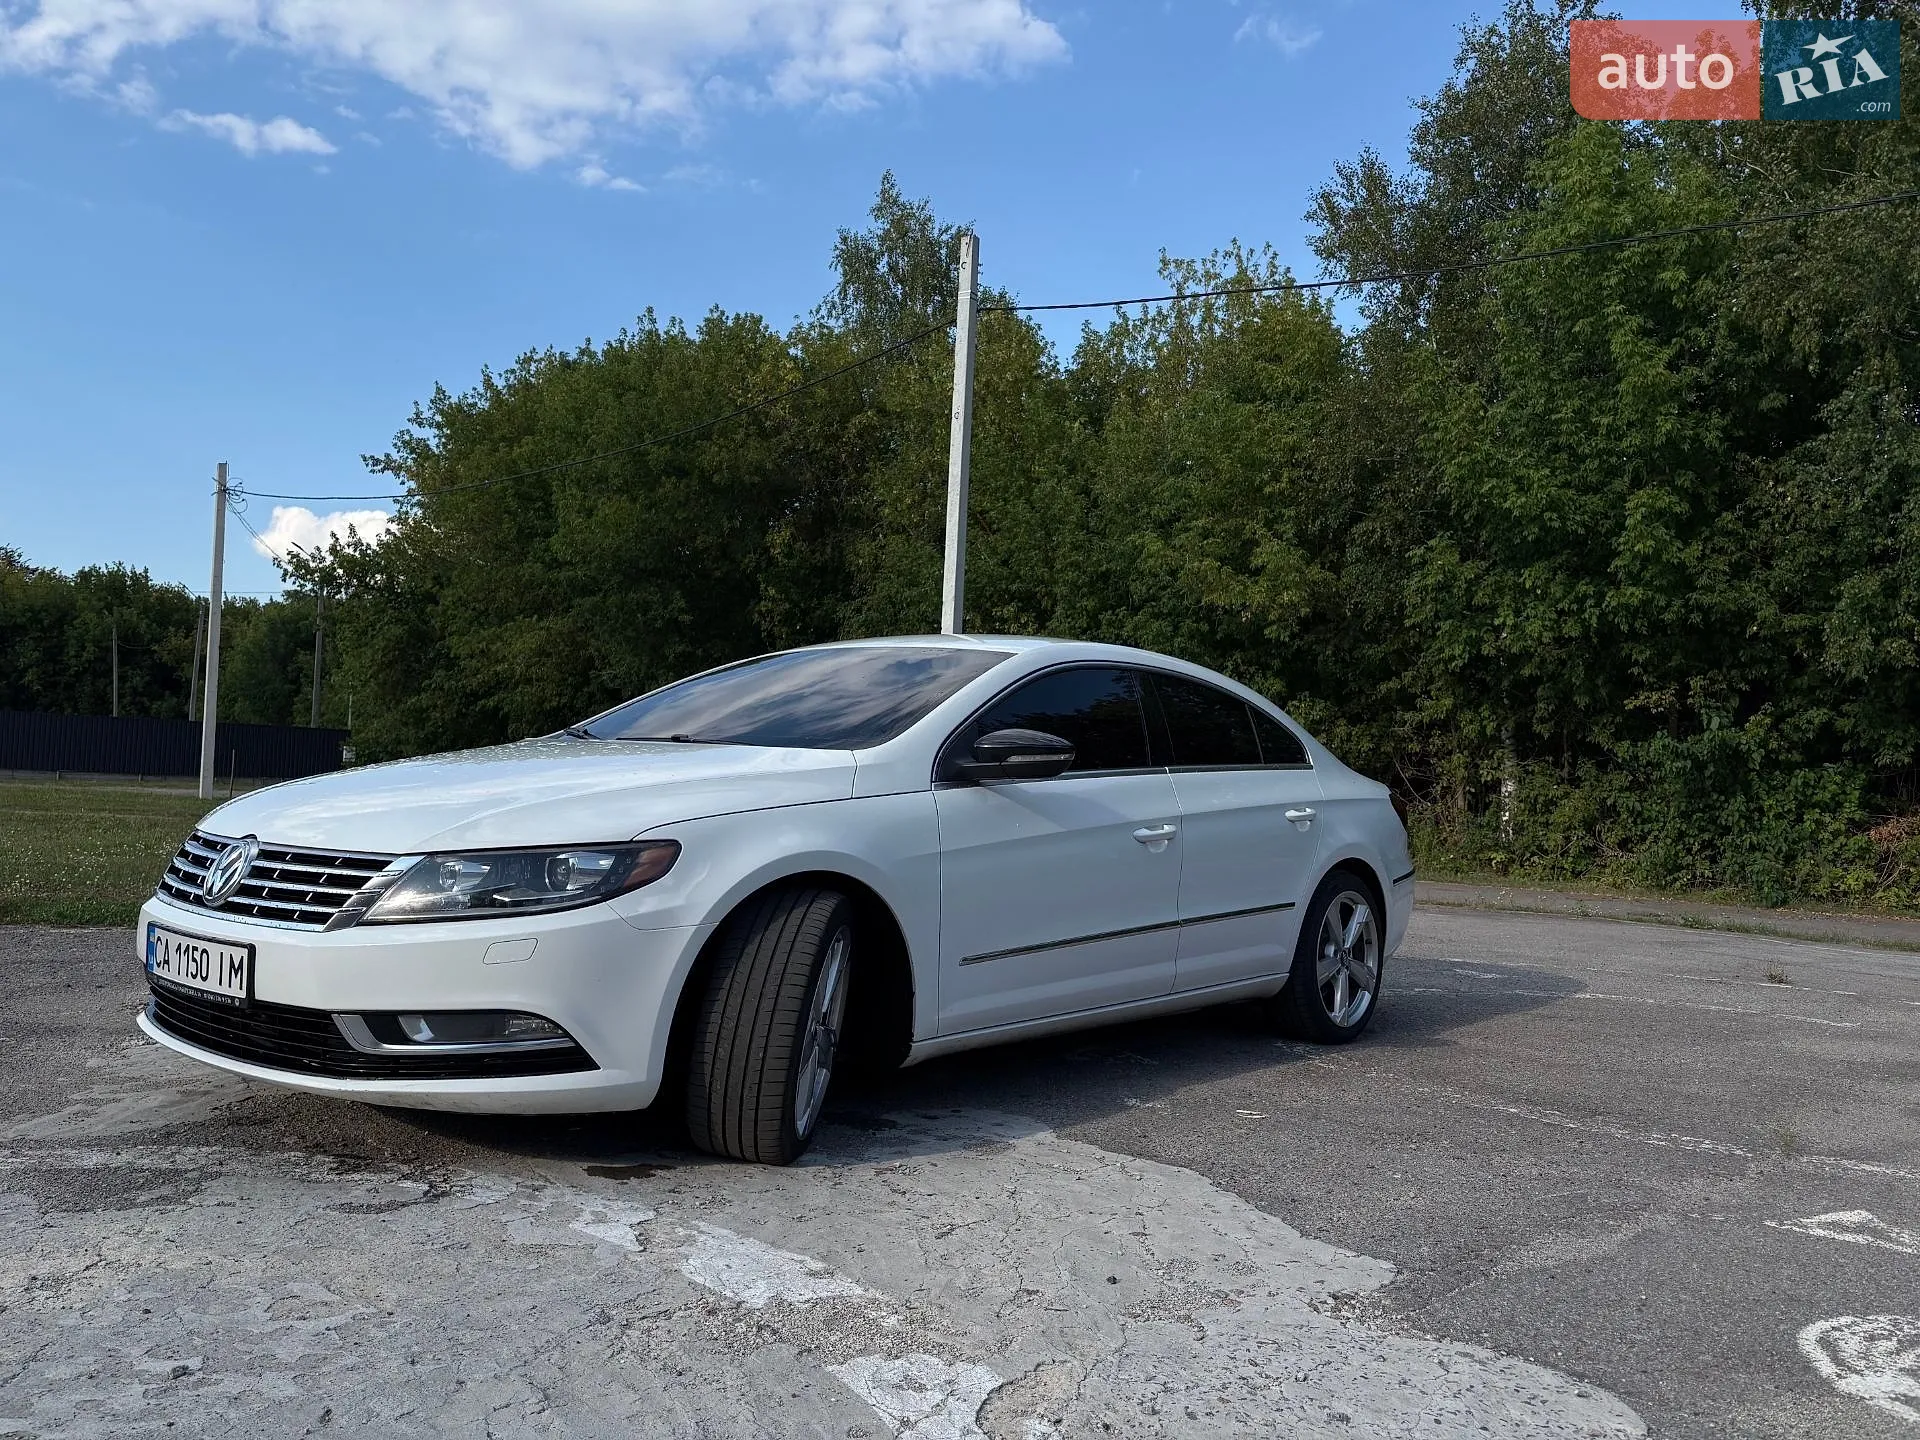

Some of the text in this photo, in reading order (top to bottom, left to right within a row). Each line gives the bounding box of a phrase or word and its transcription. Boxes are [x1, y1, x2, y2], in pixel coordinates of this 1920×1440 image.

[154, 935, 244, 990] CA 1150 IM
